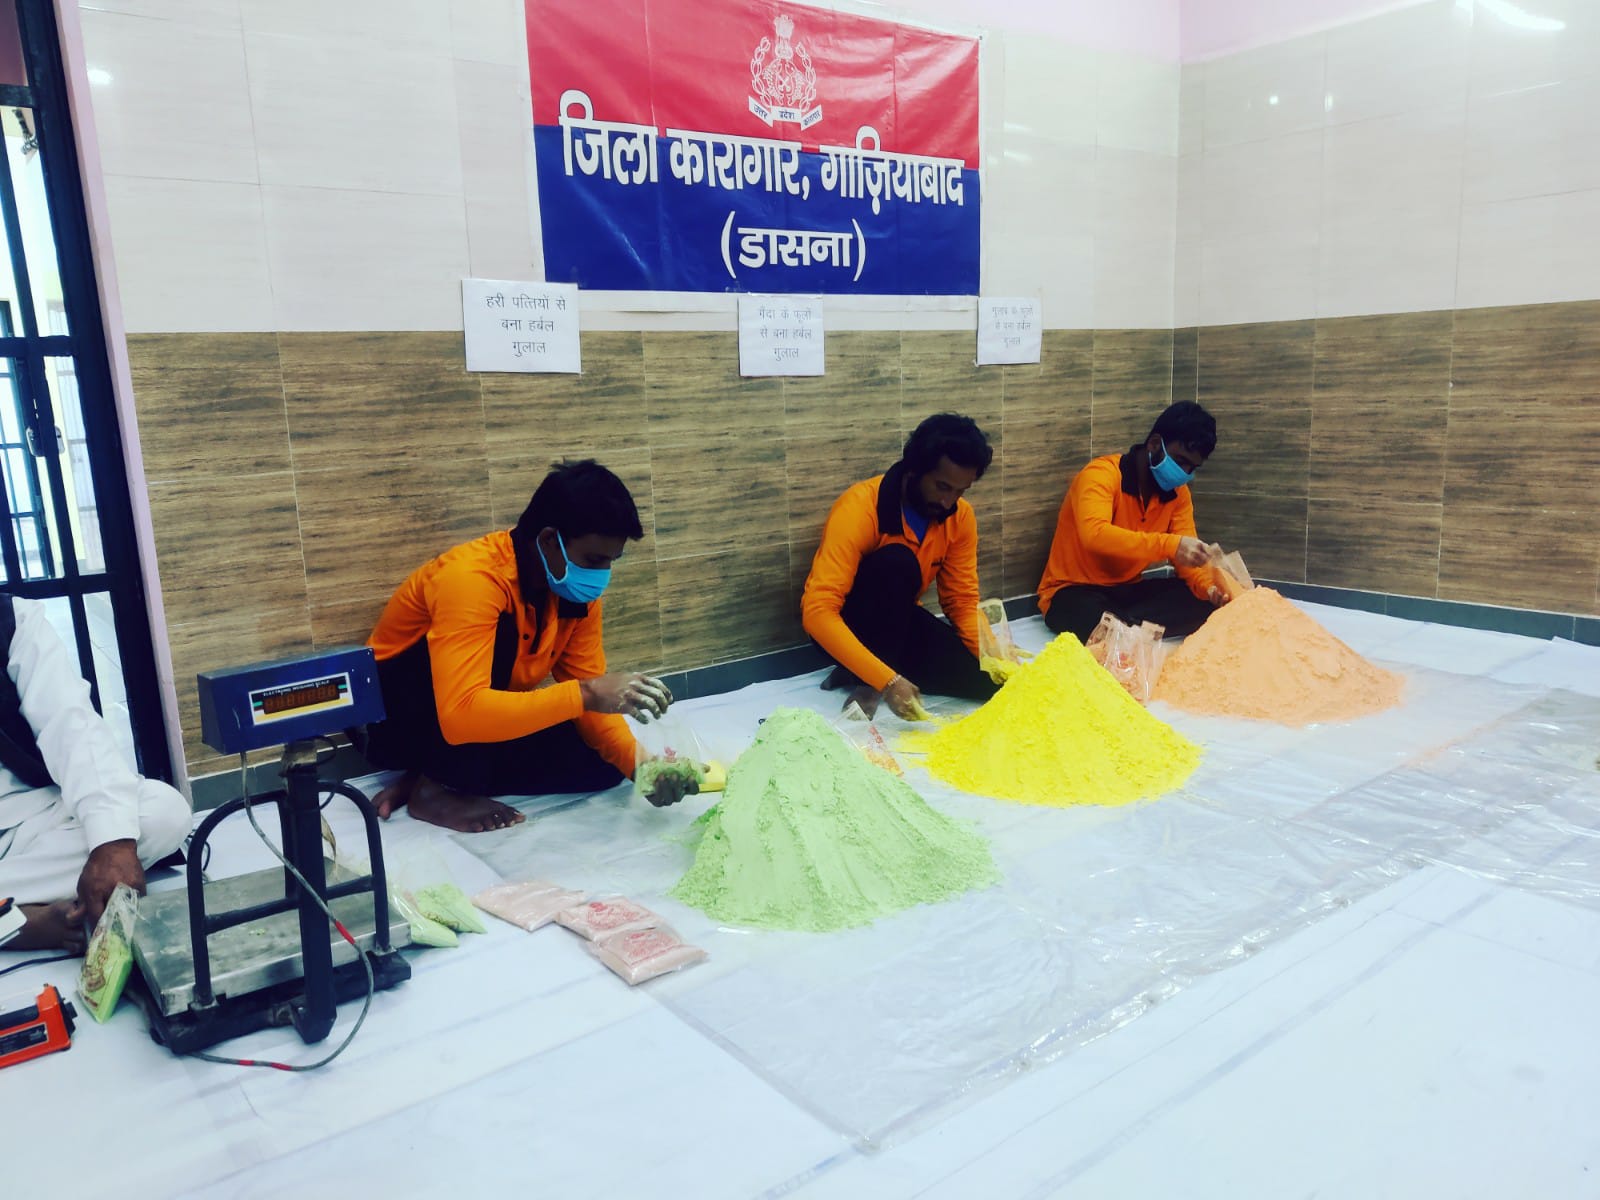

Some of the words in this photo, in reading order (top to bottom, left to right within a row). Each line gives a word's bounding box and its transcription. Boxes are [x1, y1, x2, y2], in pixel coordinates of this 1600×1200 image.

[558, 89, 659, 185] जिला
[664, 128, 811, 201] कारागार,
[818, 125, 966, 214] गाज़ियाबाद
[720, 211, 867, 282] (डासना)
[486, 292, 504, 308] हरी
[511, 292, 550, 311] पत्तियों
[556, 295, 566, 311] से
[499, 319, 522, 332] बना
[512, 341, 547, 358] गुलाल
[774, 347, 799, 361] गुलाल
